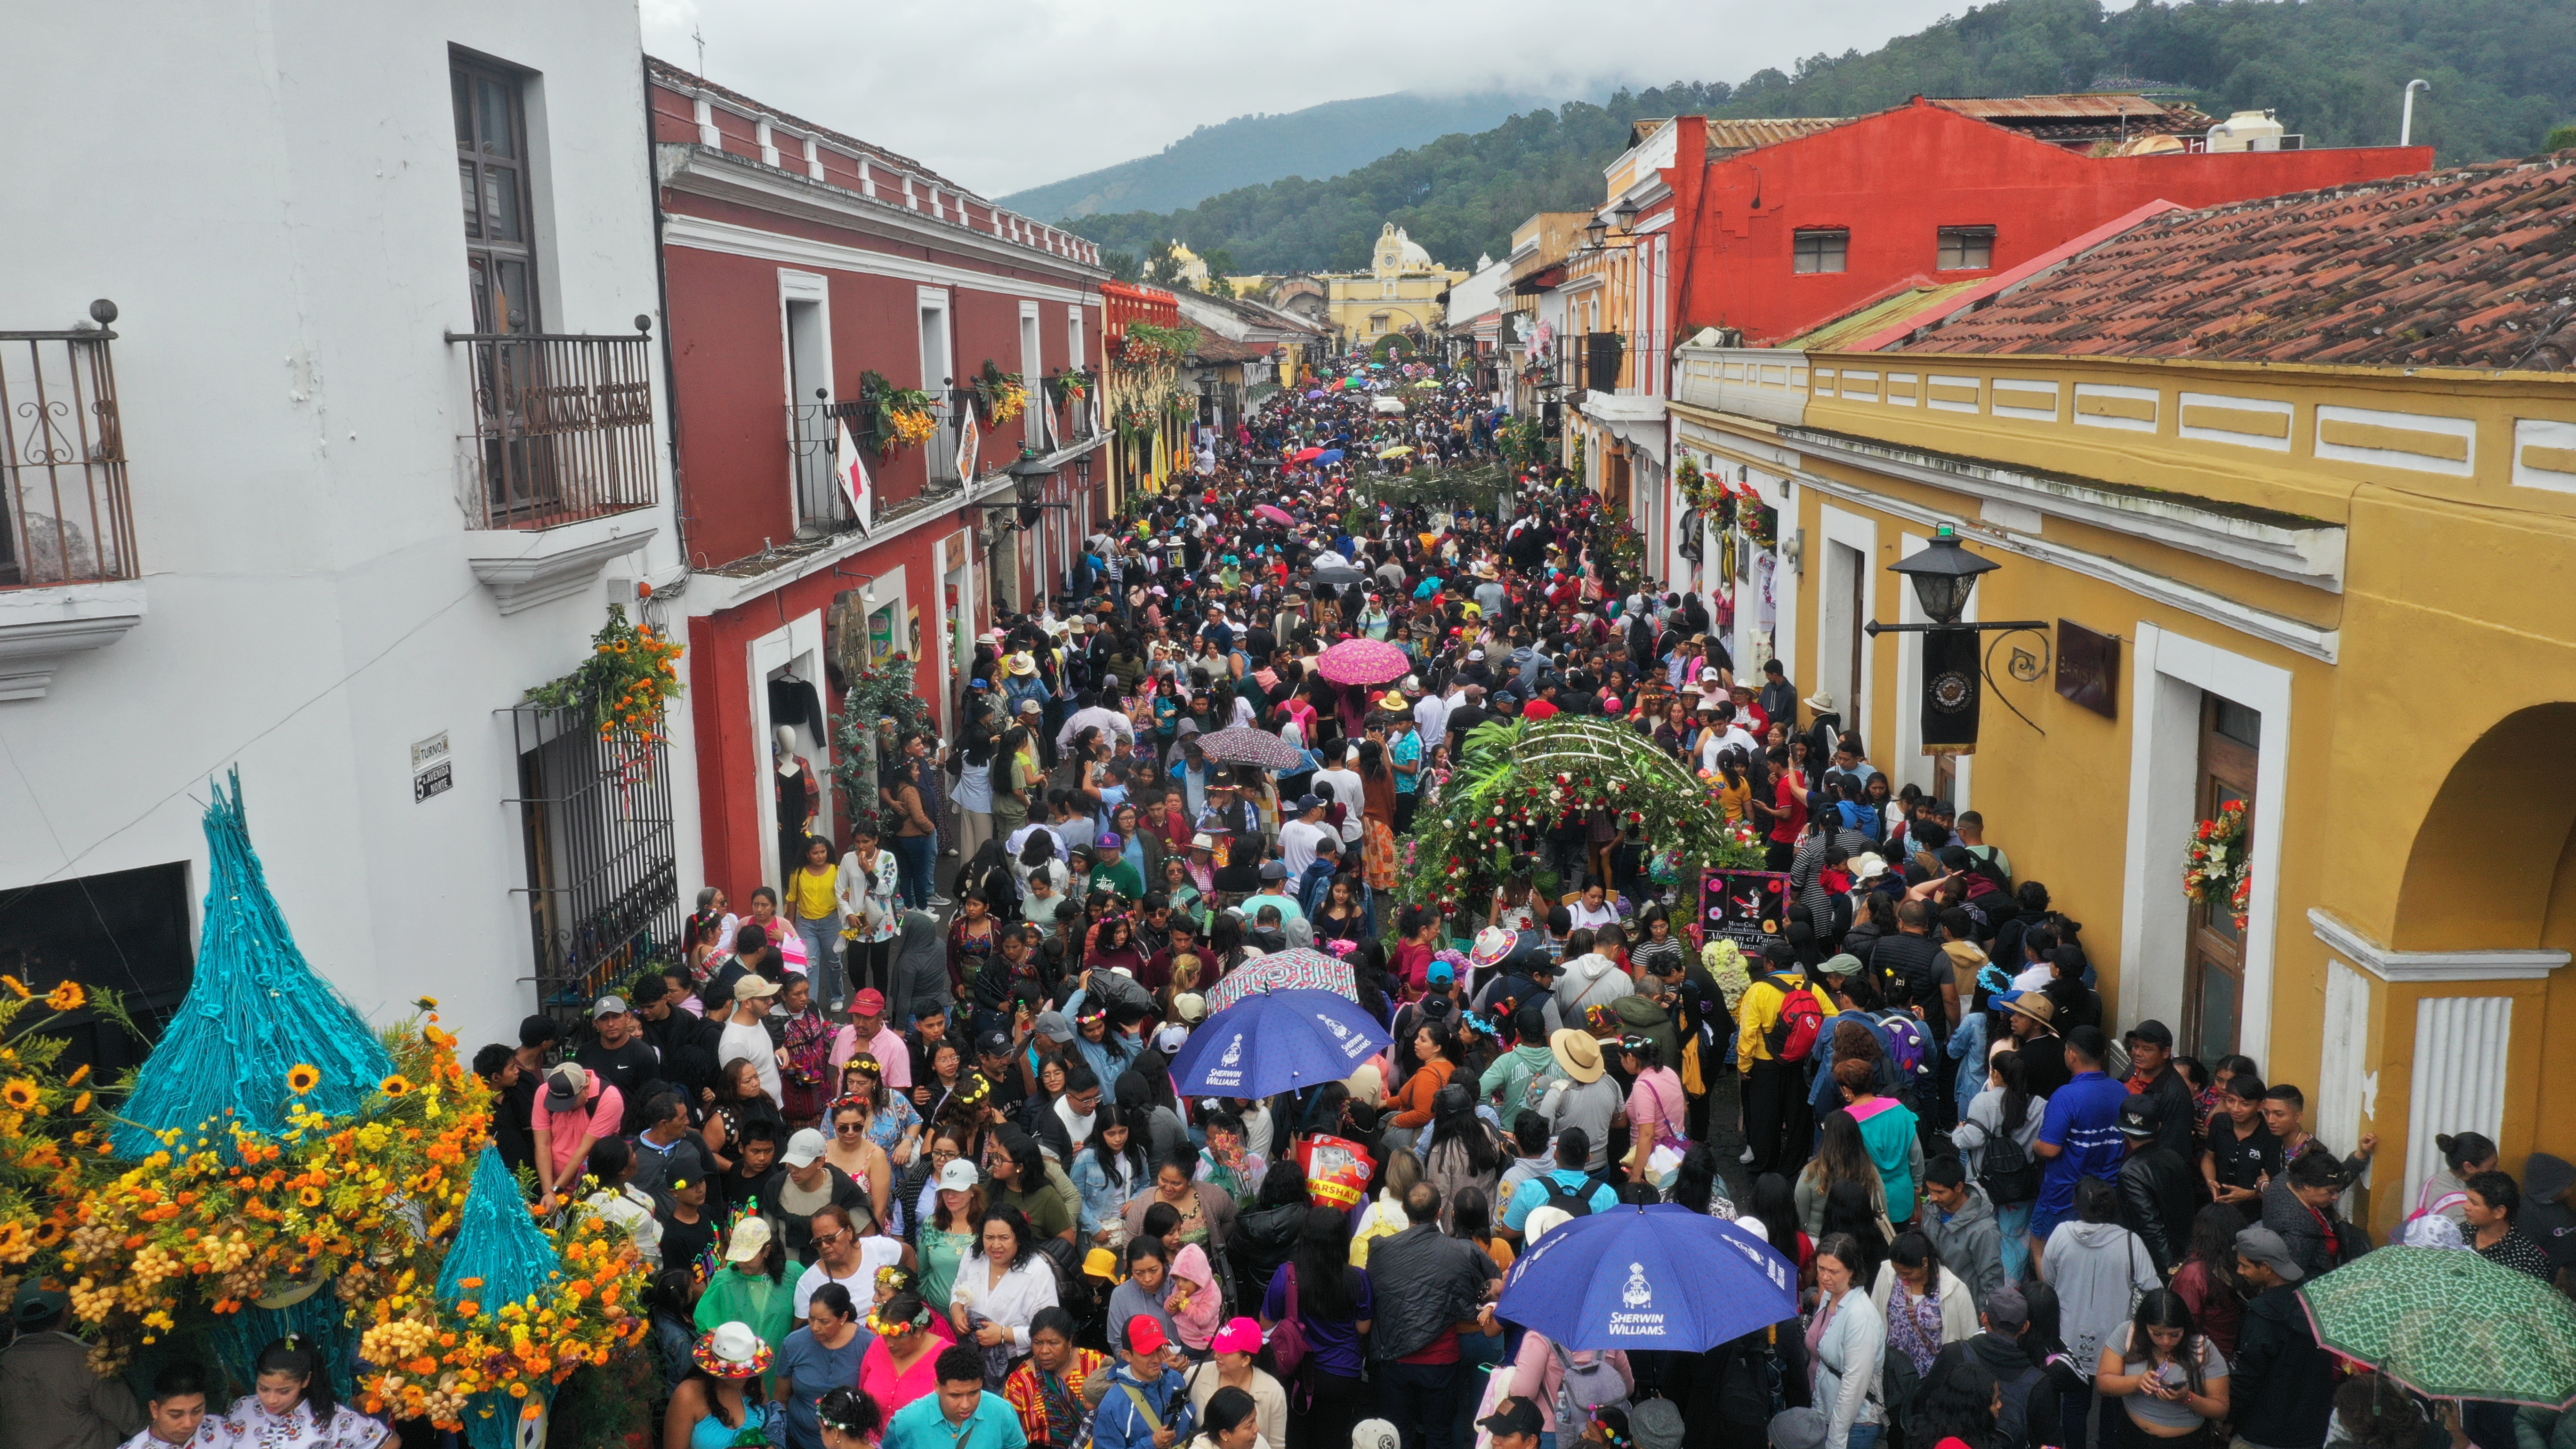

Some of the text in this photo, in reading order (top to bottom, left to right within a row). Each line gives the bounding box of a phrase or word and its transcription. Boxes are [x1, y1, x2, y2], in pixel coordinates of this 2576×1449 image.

[420, 742, 442, 760] TURNO
[427, 765, 449, 783] AVENIDA
[430, 778, 448, 794] NORTE
[1709, 932, 1732, 940] Alicia
[1342, 1033, 1365, 1053] SHERWIN
[1347, 1039, 1372, 1059] WILLIAMS
[1208, 1068, 1242, 1078] SHERWIN
[1206, 1077, 1240, 1087] WILLIAMS
[1306, 1181, 1359, 1201] MARSHALL
[1610, 1312, 1664, 1323] SHERWIN
[1609, 1323, 1666, 1335] WILLIAMS
